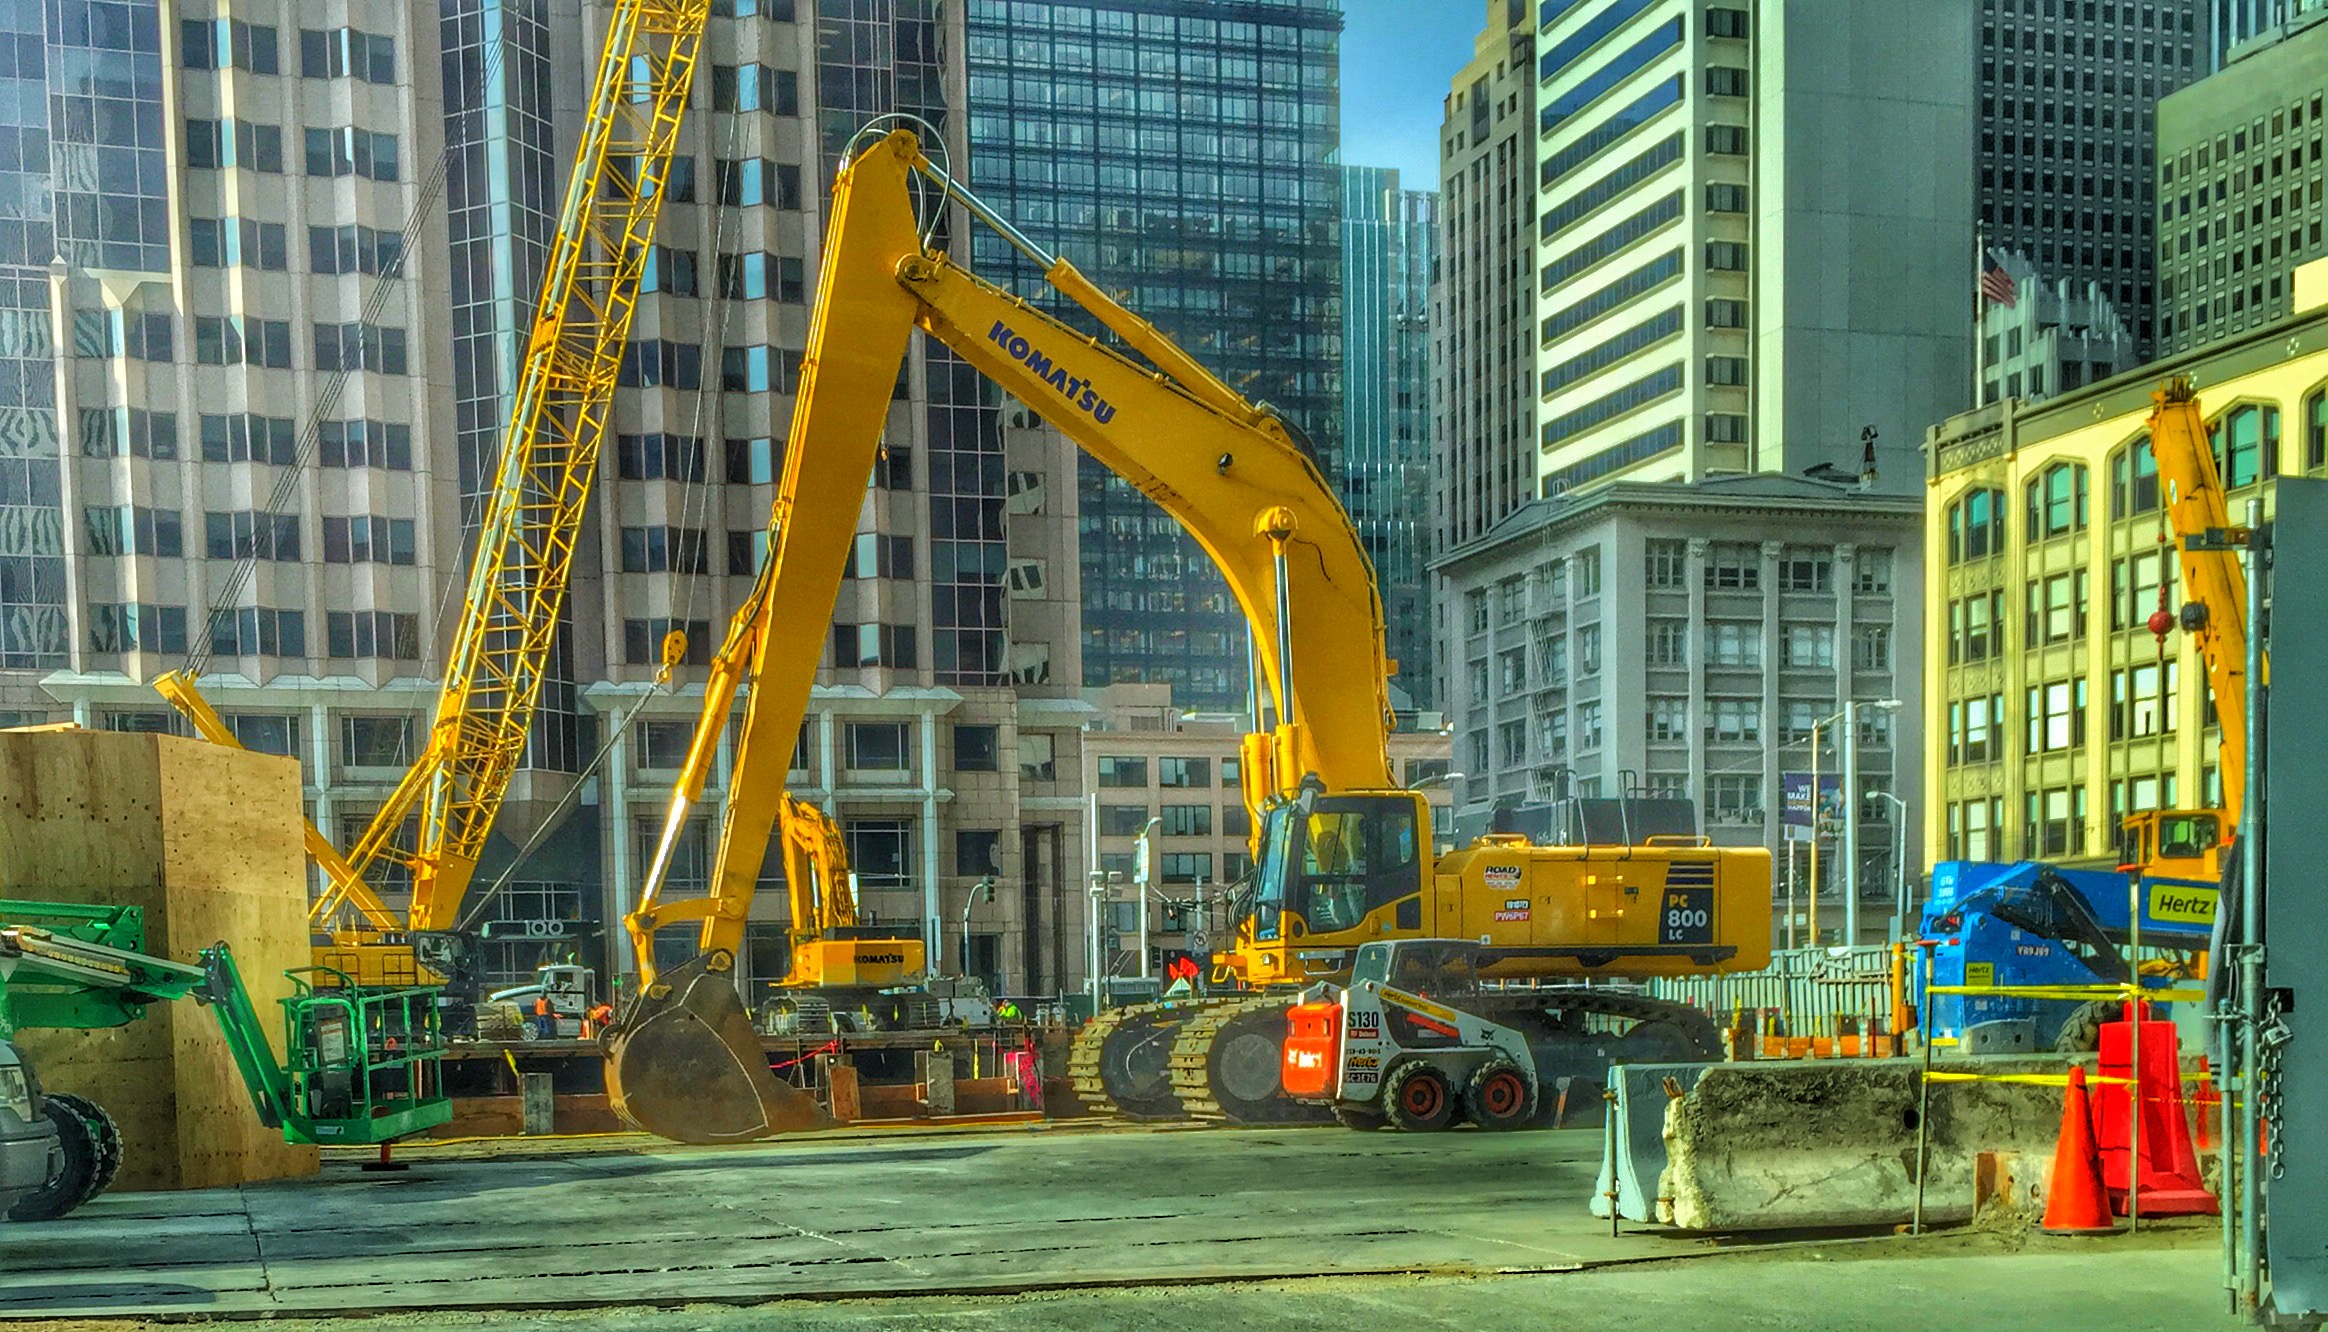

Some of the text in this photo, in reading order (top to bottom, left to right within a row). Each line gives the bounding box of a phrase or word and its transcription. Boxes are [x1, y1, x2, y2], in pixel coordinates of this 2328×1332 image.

[987, 319, 1117, 424] KOMATSU
[1485, 866, 1517, 874] ROAD
[1669, 894, 1688, 908] PC
[2158, 894, 2210, 915] Hertz
[1667, 909, 1707, 928] 800
[525, 919, 564, 936] 100
[1668, 929, 1684, 941] LC
[854, 953, 904, 964] KOMATSU
[1968, 964, 1989, 974] Hertz
[1348, 1011, 1379, 1028] S130
